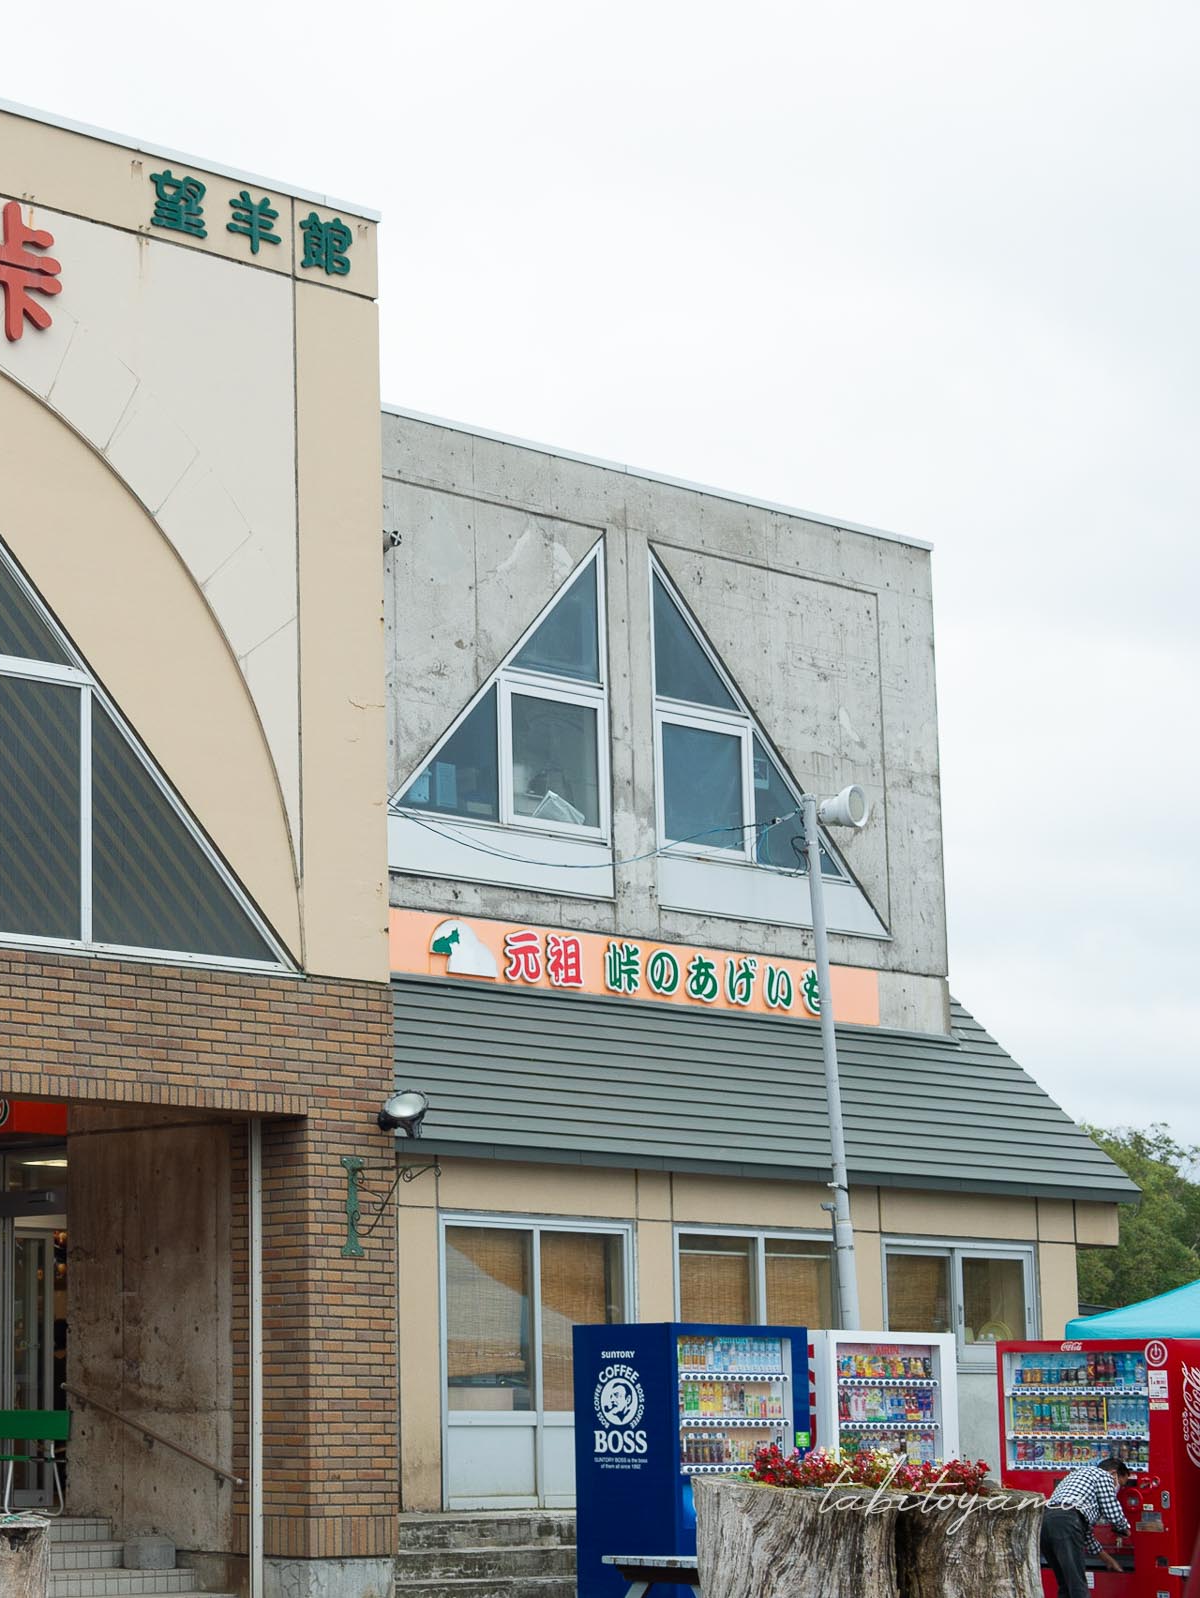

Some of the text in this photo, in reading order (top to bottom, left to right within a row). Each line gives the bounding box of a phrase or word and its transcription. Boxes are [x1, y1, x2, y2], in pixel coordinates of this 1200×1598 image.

[150, 168, 354, 277] 望羊館
[504, 930, 585, 987] 元祖
[601, 1350, 636, 1359] SUNTORY
[598, 1364, 640, 1383] COFFEE
[594, 1430, 648, 1454] BOSS
